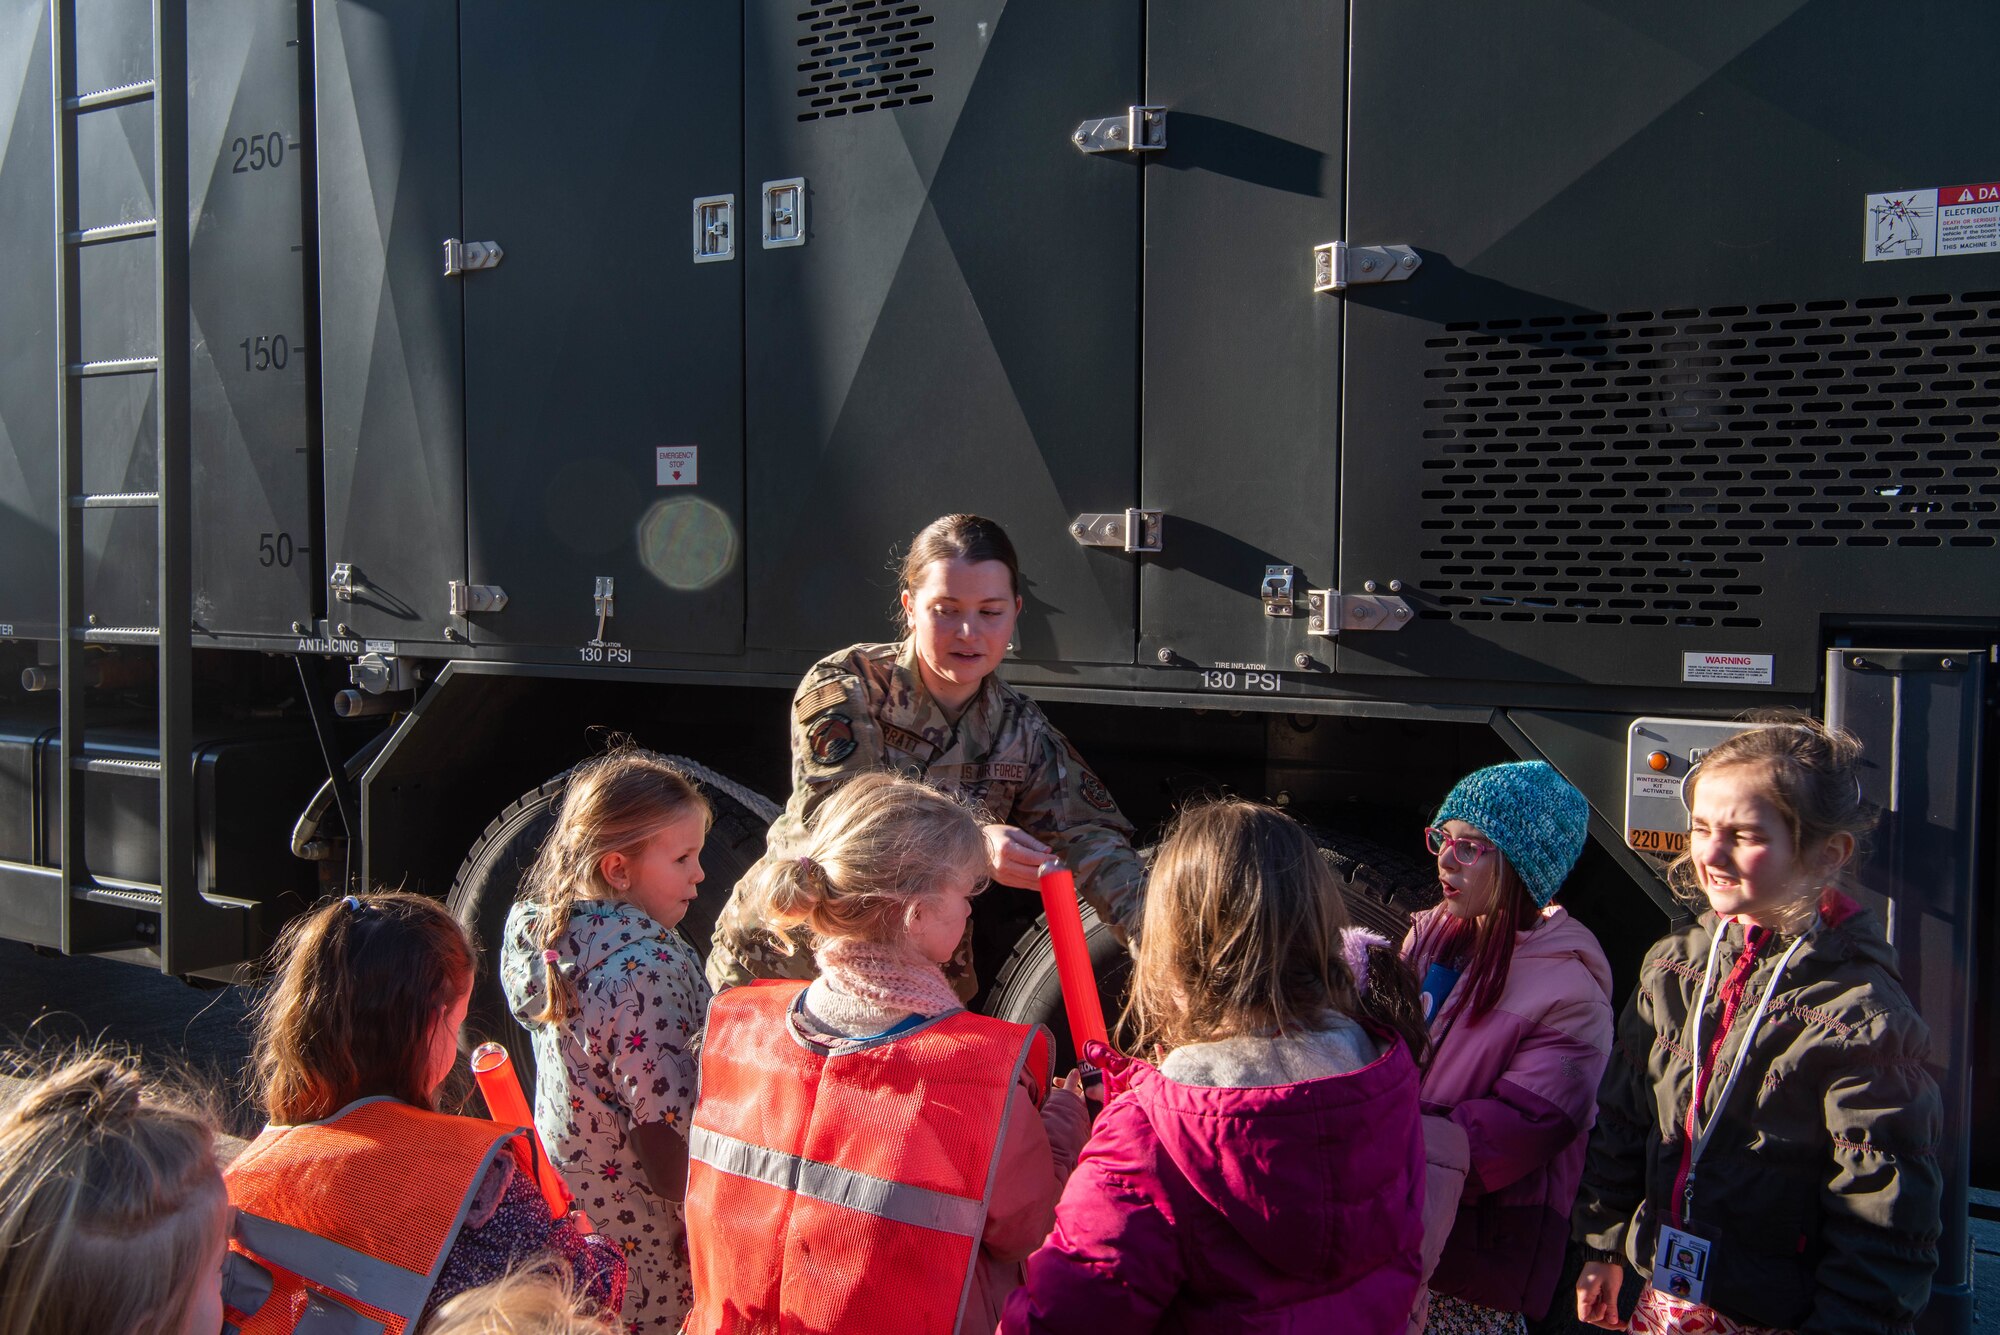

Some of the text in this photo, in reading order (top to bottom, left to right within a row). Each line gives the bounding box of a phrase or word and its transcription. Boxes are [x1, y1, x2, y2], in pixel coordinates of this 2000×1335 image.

[232, 131, 284, 174] 250
[1979, 187, 1999, 200] DA
[1944, 205, 2000, 217] ELECTROCUT
[239, 334, 288, 372] 150
[659, 451, 693, 459] EMERGENCY
[259, 532, 293, 567] 50
[298, 638, 359, 653] ANTI-ICING
[579, 648, 631, 663] 130 PSI
[1705, 656, 1751, 665] WARNING
[1200, 671, 1281, 691] 130 PSI
[977, 764, 991, 779] AIR
[994, 763, 1023, 778] FORCE
[1636, 776, 1681, 785] WINTERIZATION
[1632, 830, 1660, 849] 220
